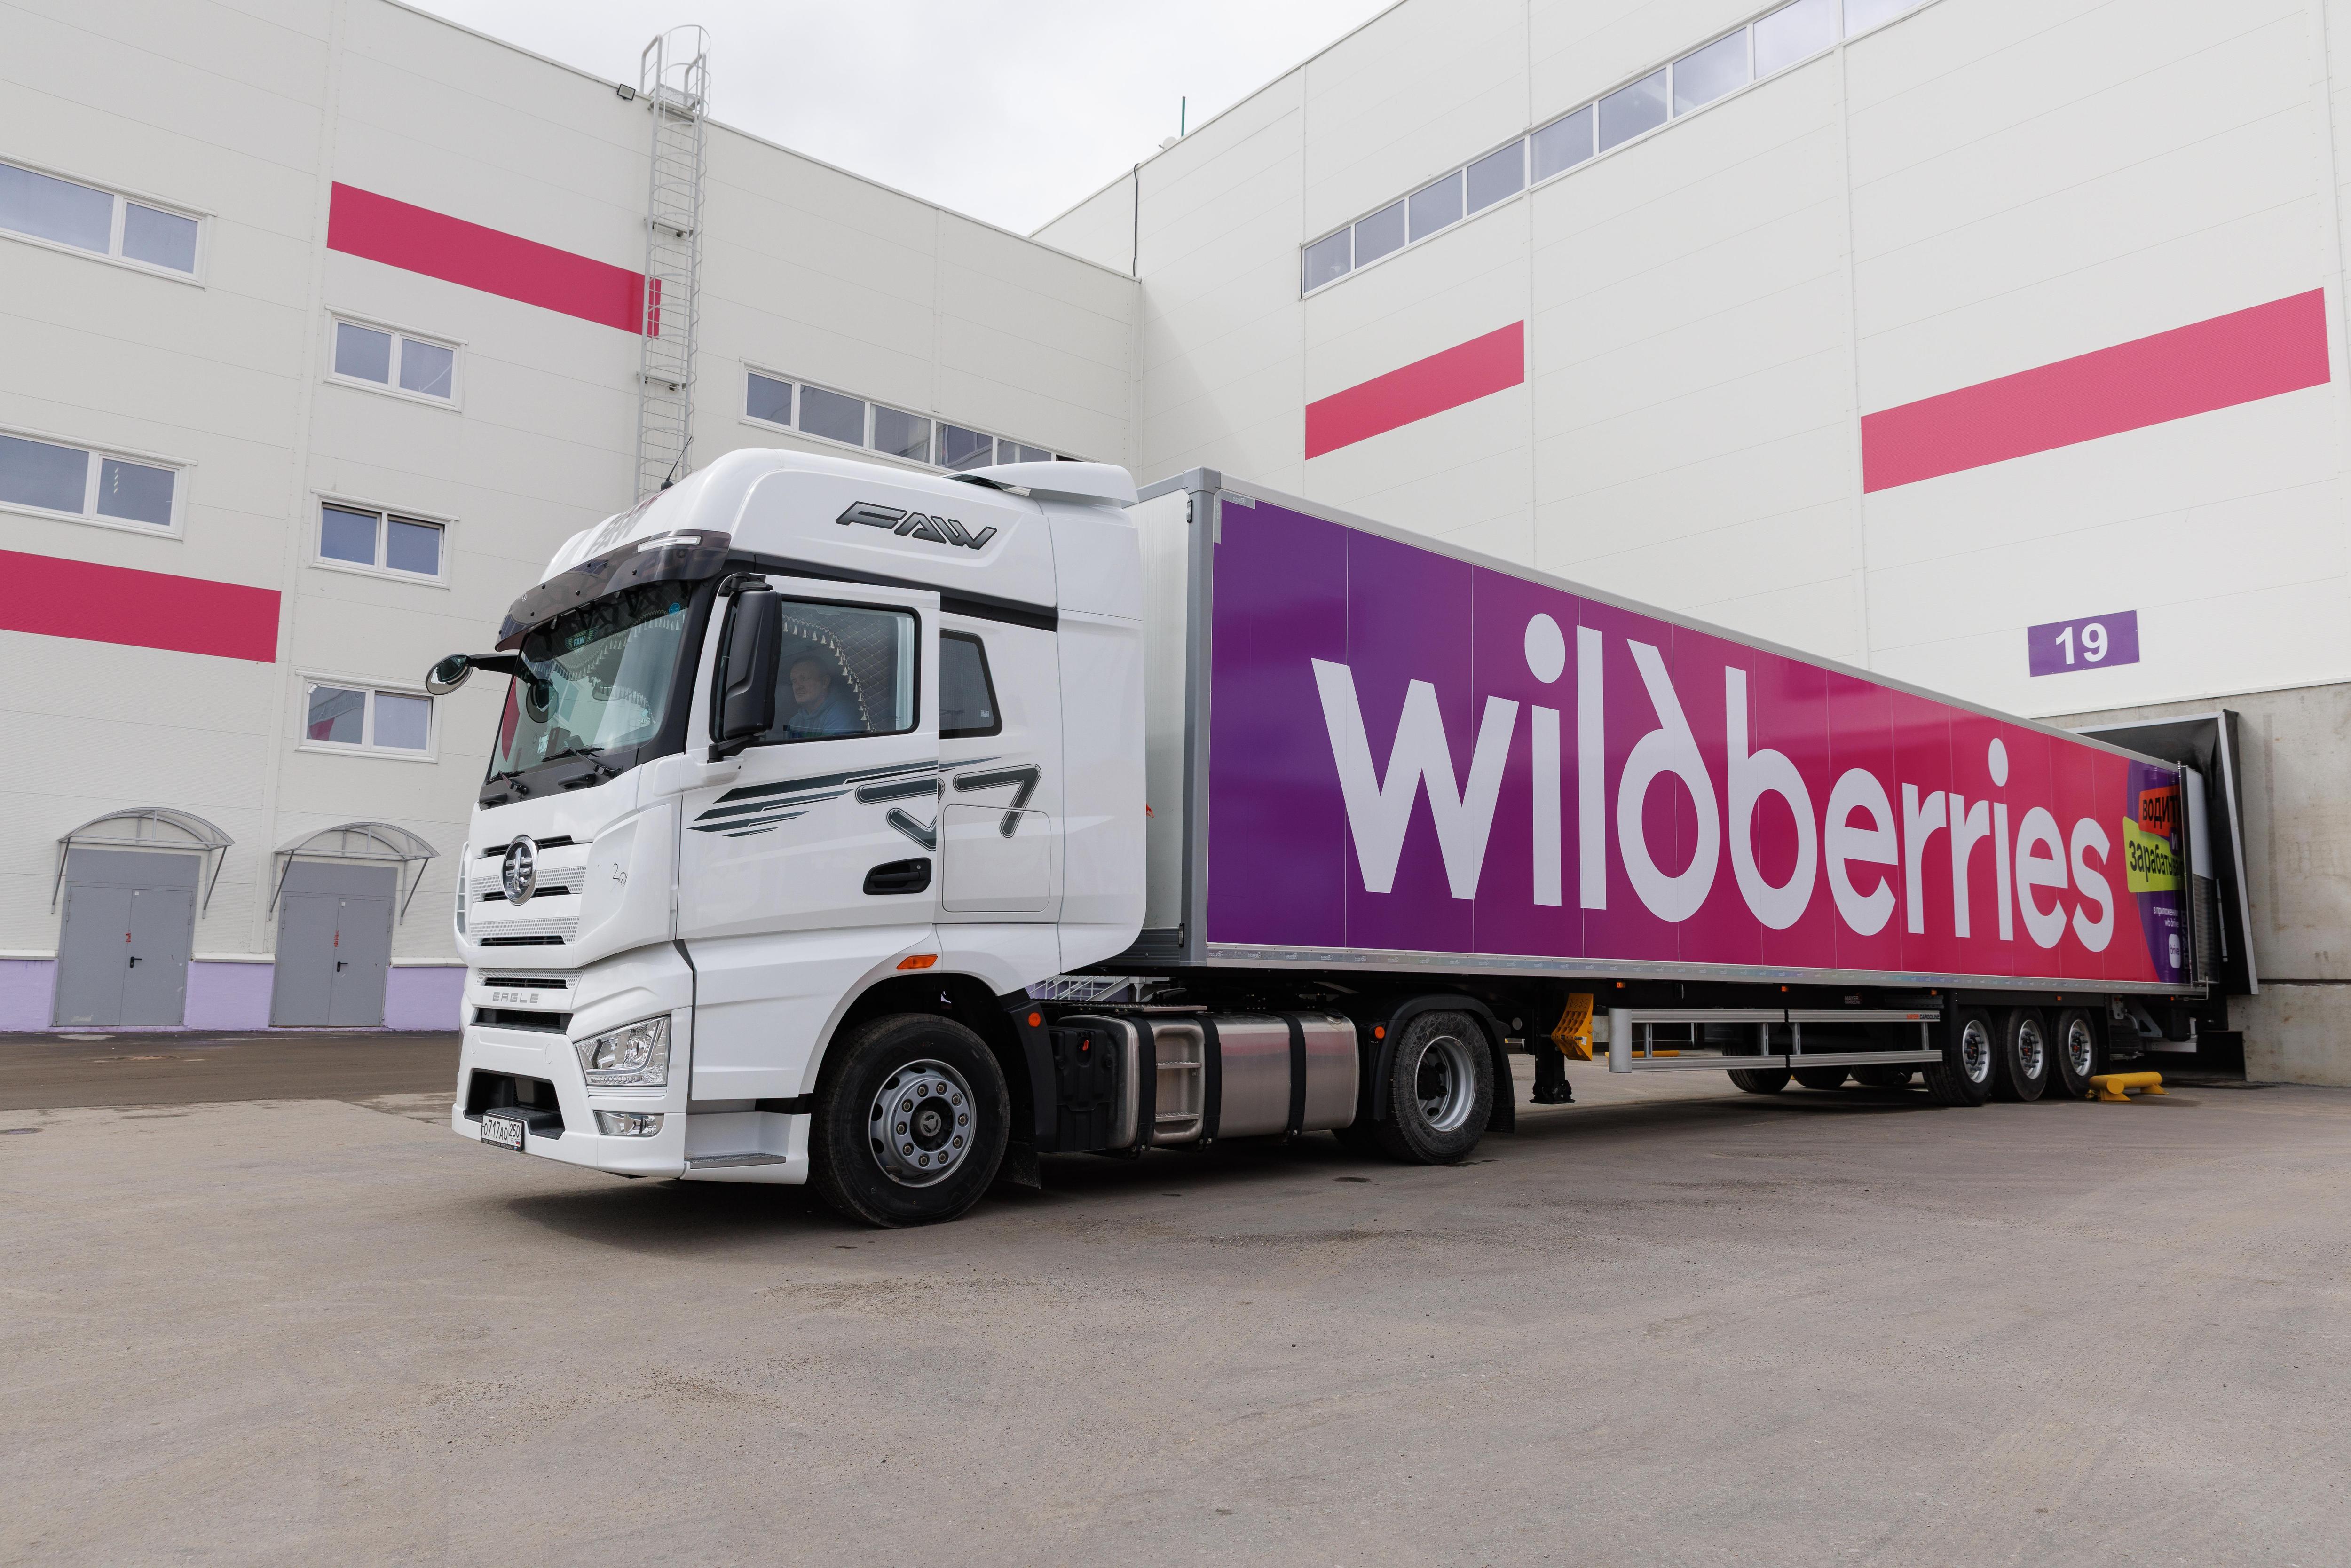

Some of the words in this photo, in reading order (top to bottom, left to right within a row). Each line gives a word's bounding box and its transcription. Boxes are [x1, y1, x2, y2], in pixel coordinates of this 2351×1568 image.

[836, 501, 997, 550] FAW
[574, 635, 585, 647] FAW
[2055, 623, 2108, 665] 19
[1311, 613, 2114, 952] wildberries
[2170, 944, 2180, 955] drive
[492, 992, 539, 1004] EAGLE
[509, 1123, 520, 1138] 250
